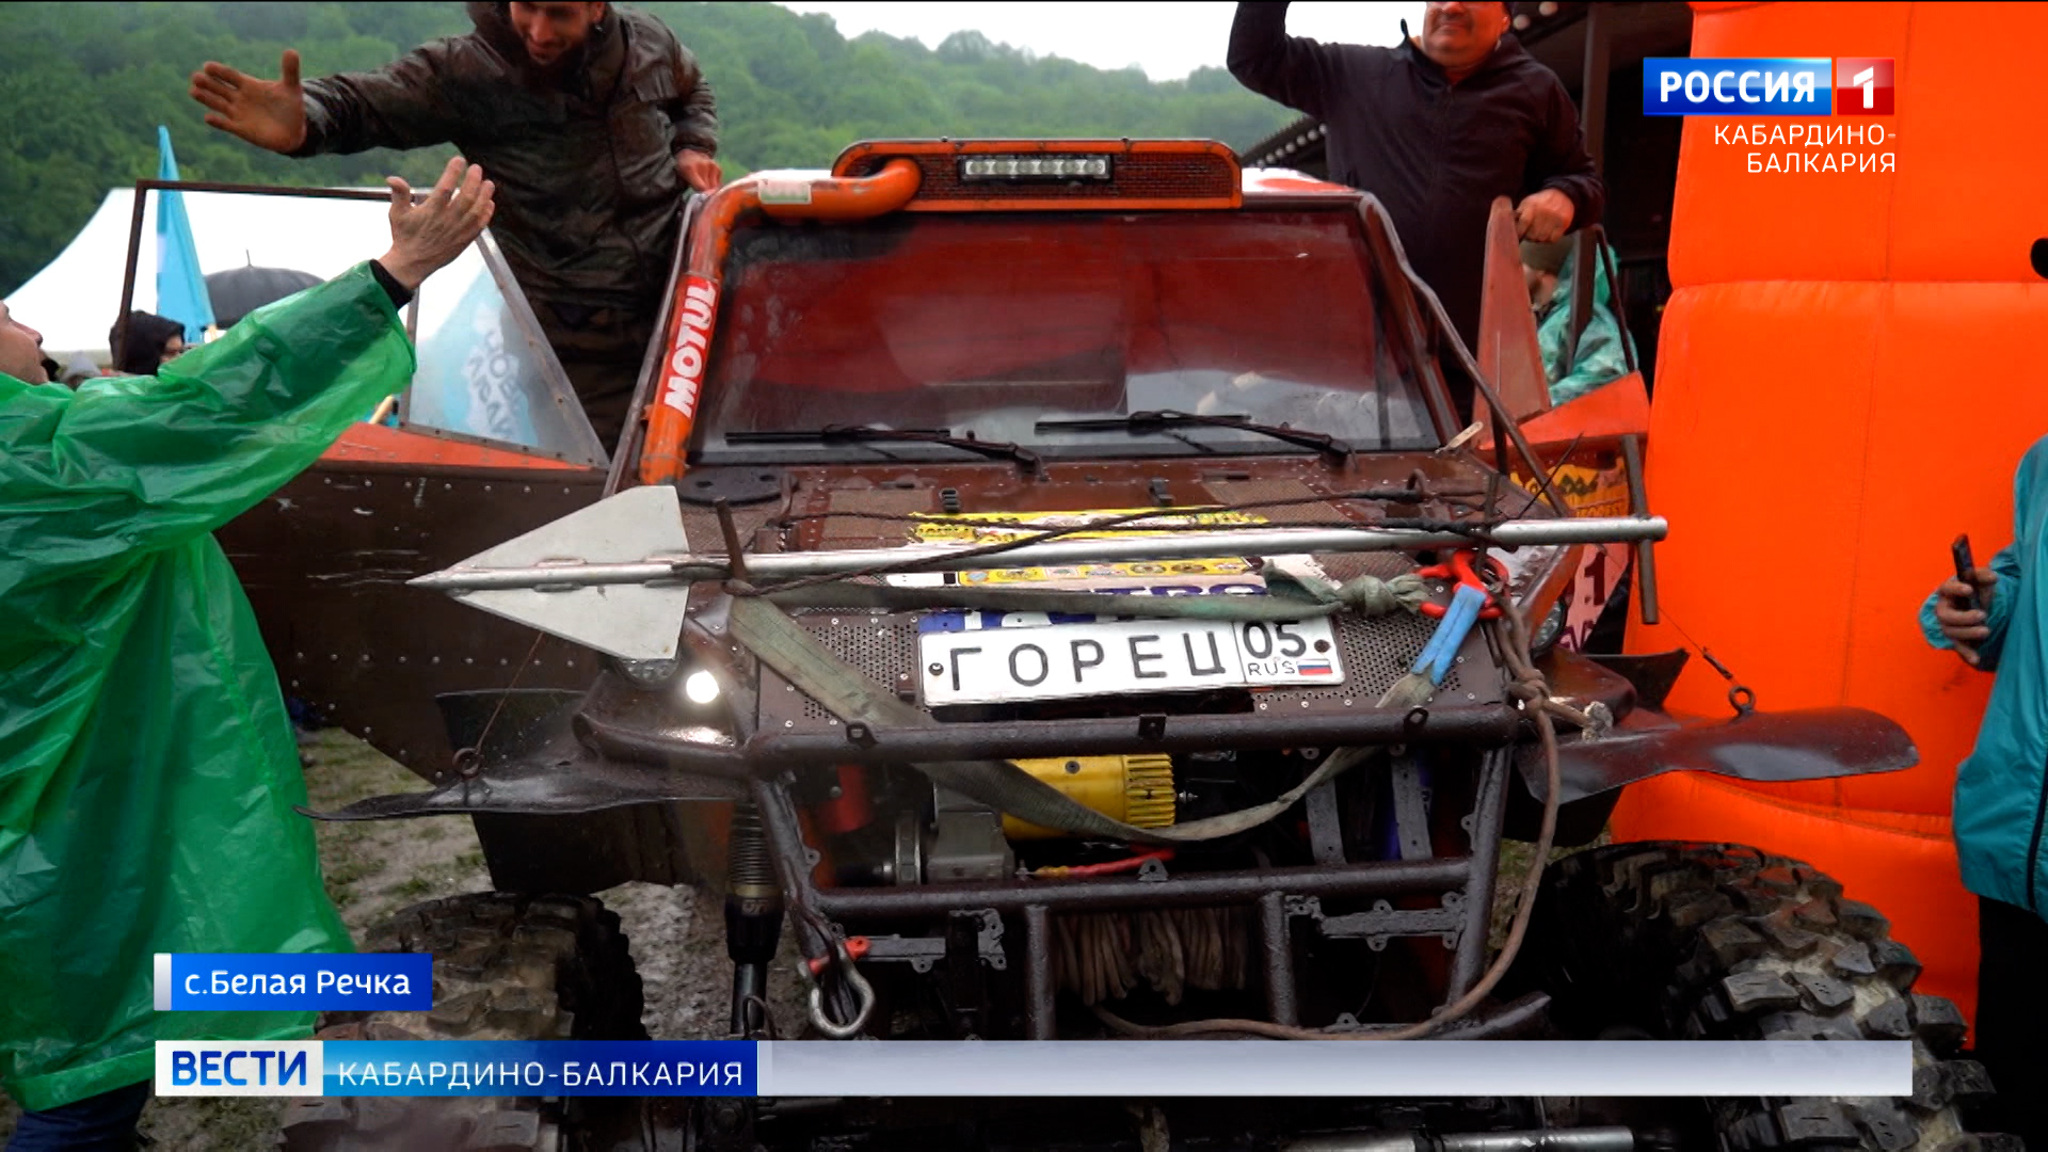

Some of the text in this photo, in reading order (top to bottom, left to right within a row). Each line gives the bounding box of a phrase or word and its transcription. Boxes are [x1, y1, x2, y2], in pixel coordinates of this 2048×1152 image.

[664, 279, 717, 419] MOTUL
[949, 631, 1227, 691] ГОРЕЦ
[1242, 620, 1307, 659] 05
[1247, 660, 1296, 676] RUS
